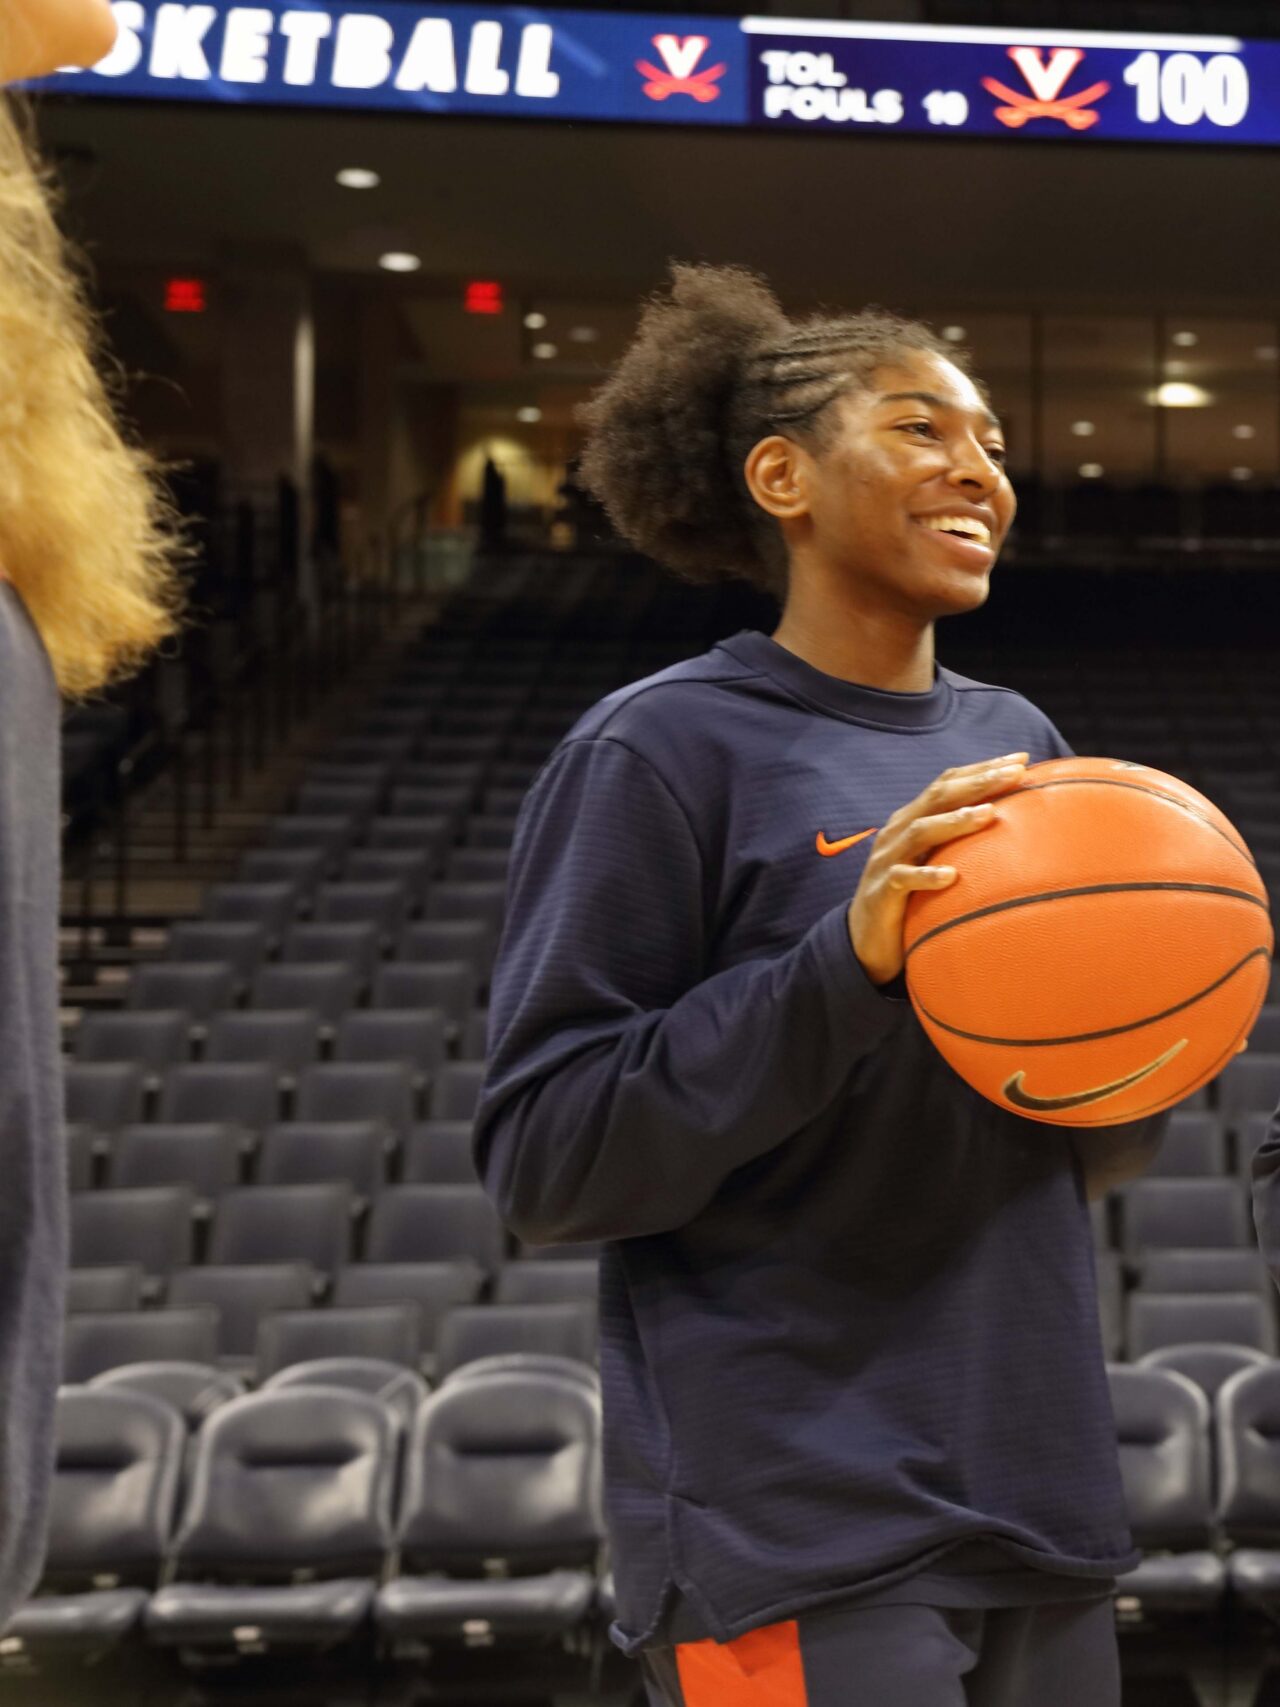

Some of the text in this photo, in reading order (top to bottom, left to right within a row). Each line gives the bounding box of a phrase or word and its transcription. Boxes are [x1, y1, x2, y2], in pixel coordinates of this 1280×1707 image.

[53, 0, 560, 98] SKETBALL
[764, 85, 904, 124] FOULS
[1123, 52, 1249, 126] 100
